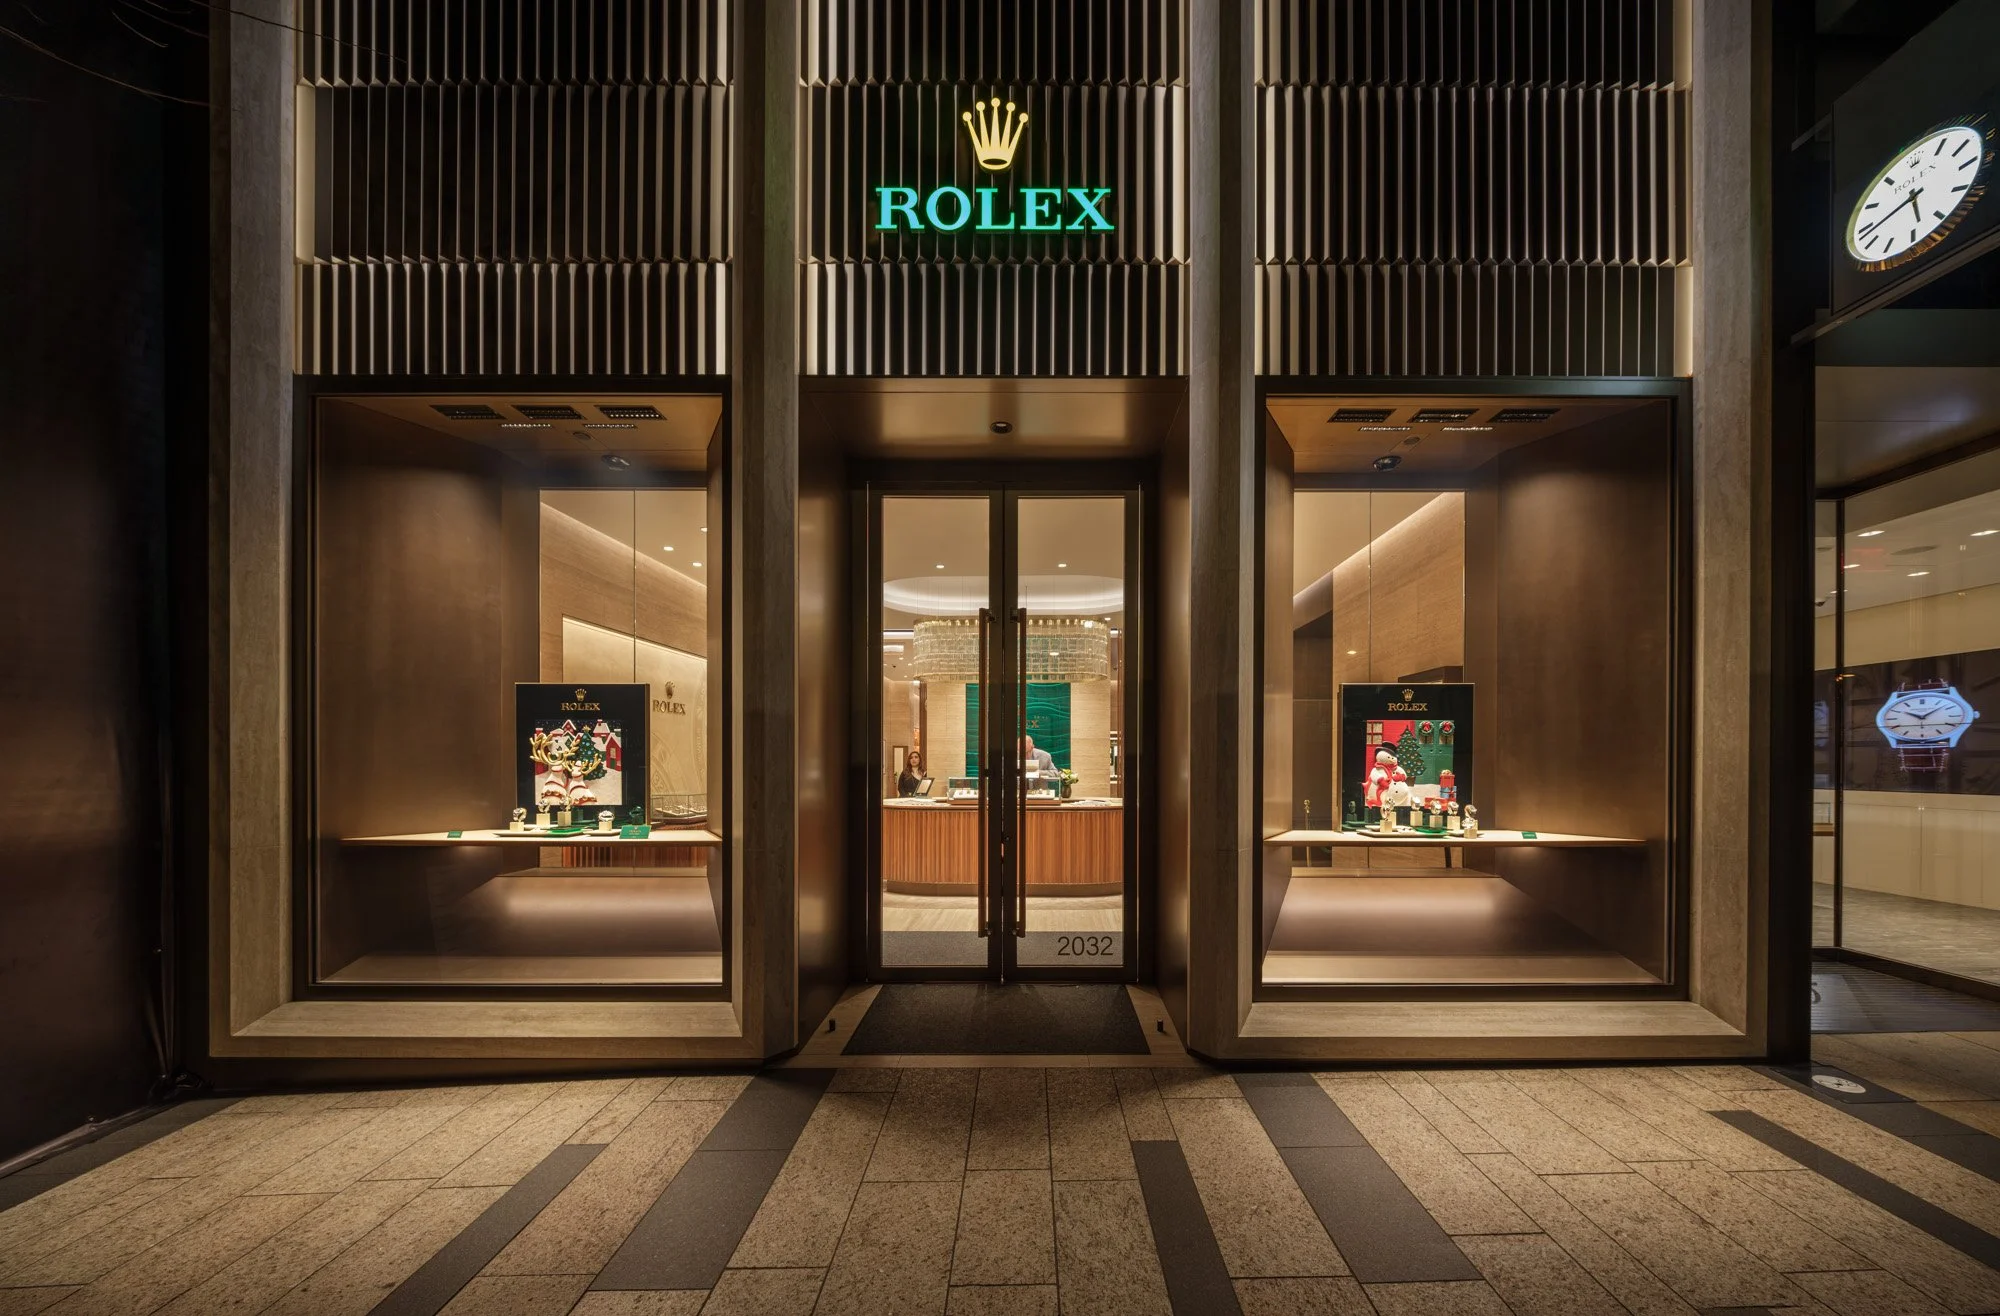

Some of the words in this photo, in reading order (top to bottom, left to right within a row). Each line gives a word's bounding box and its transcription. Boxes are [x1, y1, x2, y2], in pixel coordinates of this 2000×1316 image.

[1894, 162, 1936, 194] ROLEX
[875, 186, 1115, 231] ROLEX
[561, 702, 601, 711] ROLEX
[653, 699, 686, 715] ROLEX
[1388, 703, 1428, 711] ROLEX
[1057, 936, 1114, 956] 2032
